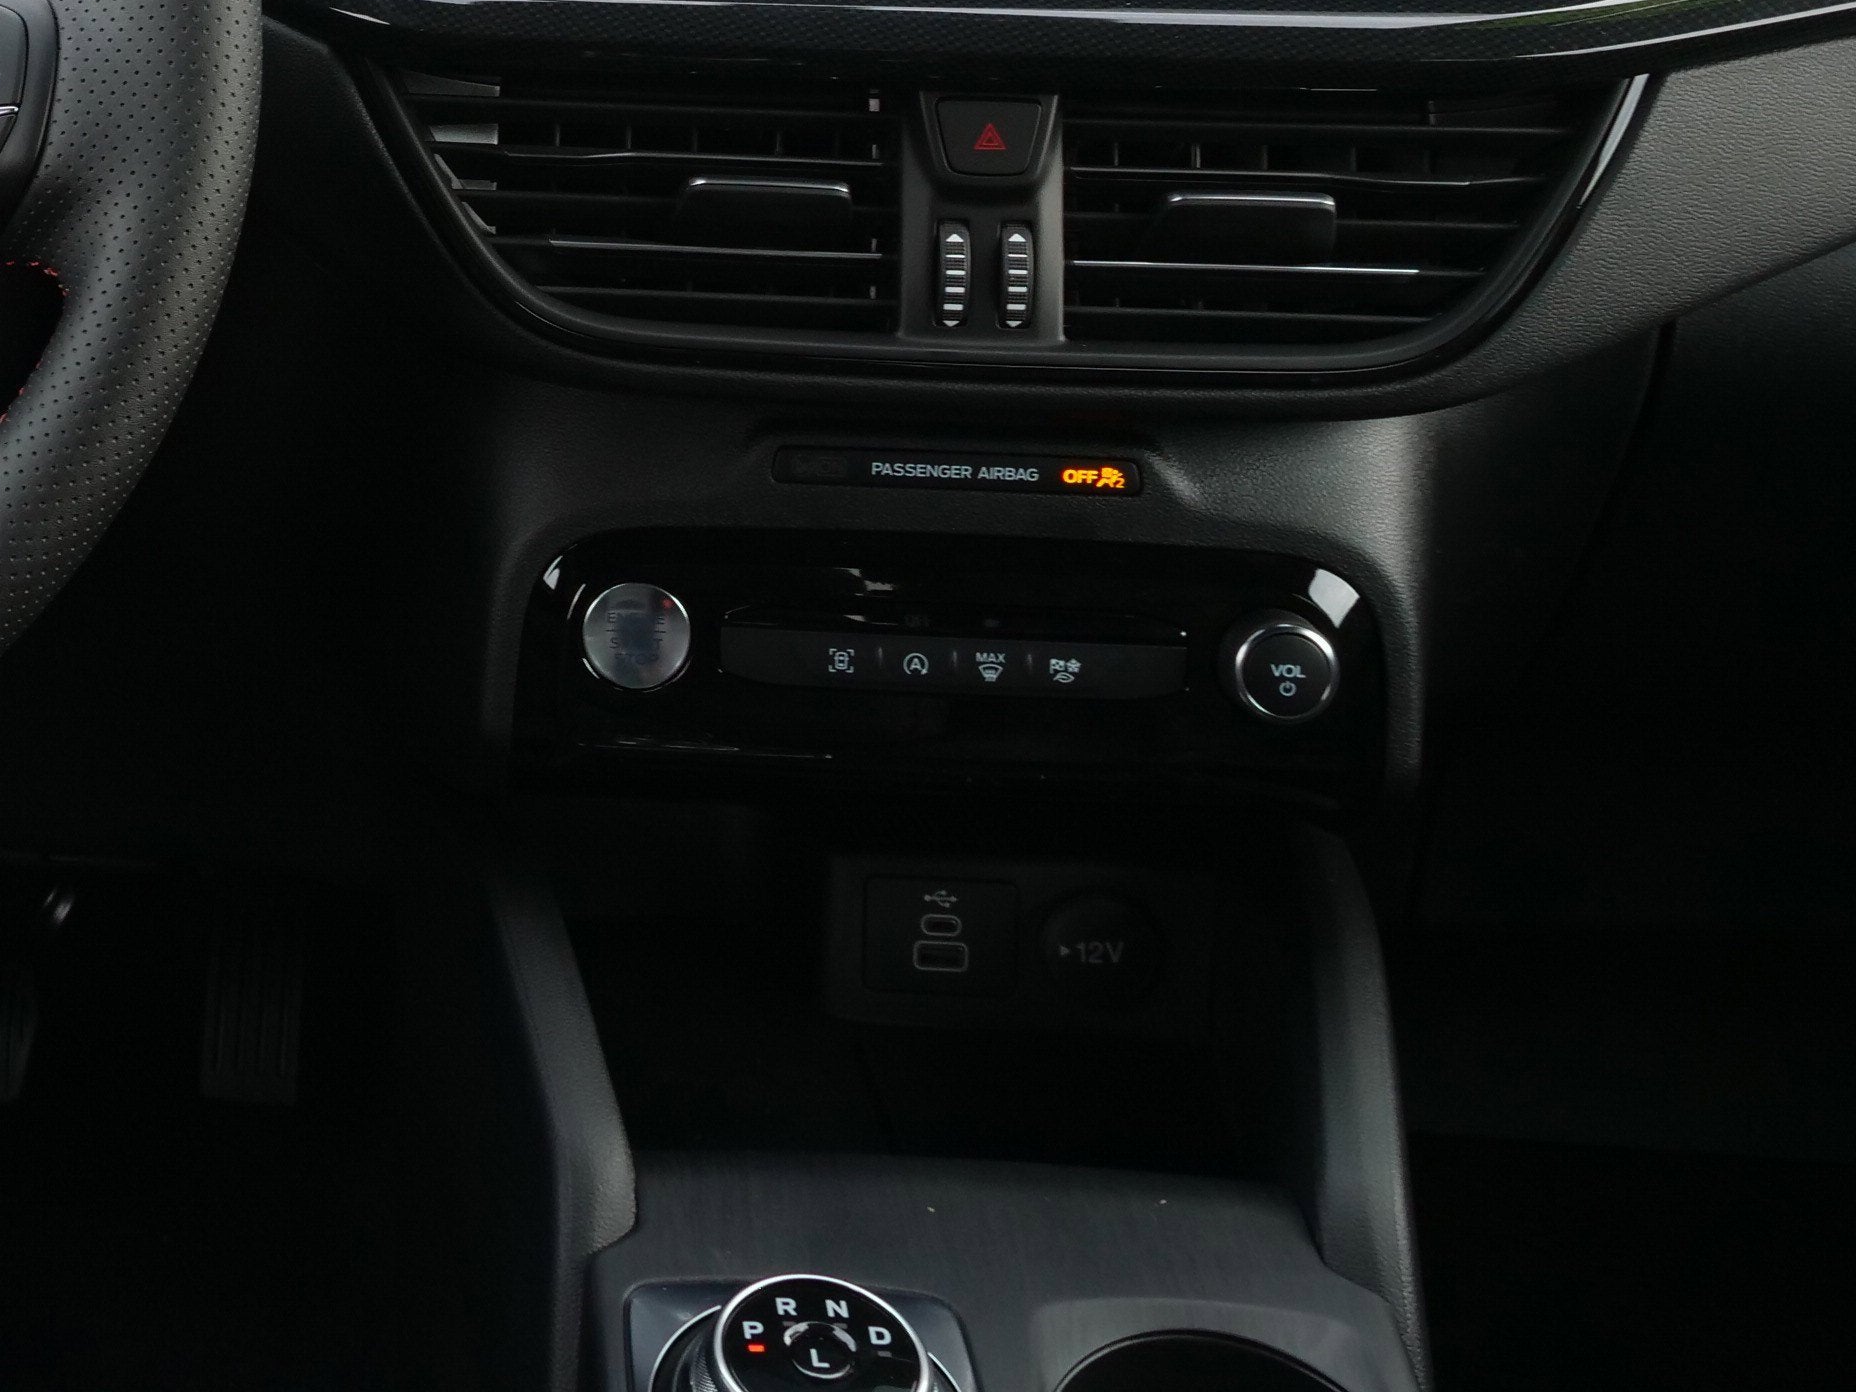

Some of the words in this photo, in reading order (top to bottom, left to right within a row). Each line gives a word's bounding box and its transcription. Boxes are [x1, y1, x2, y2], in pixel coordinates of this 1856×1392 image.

[871, 462, 973, 479] PASSENGER
[977, 466, 1040, 482] AIRBAG
[1062, 469, 1098, 485] OFF
[975, 652, 1006, 664] MAX
[1270, 664, 1307, 680] VOL
[1077, 940, 1125, 964] 12V
[775, 1297, 798, 1316] R
[824, 1299, 850, 1319] N
[742, 1320, 764, 1340] P
[867, 1326, 892, 1345] D
[809, 1348, 831, 1368] L
